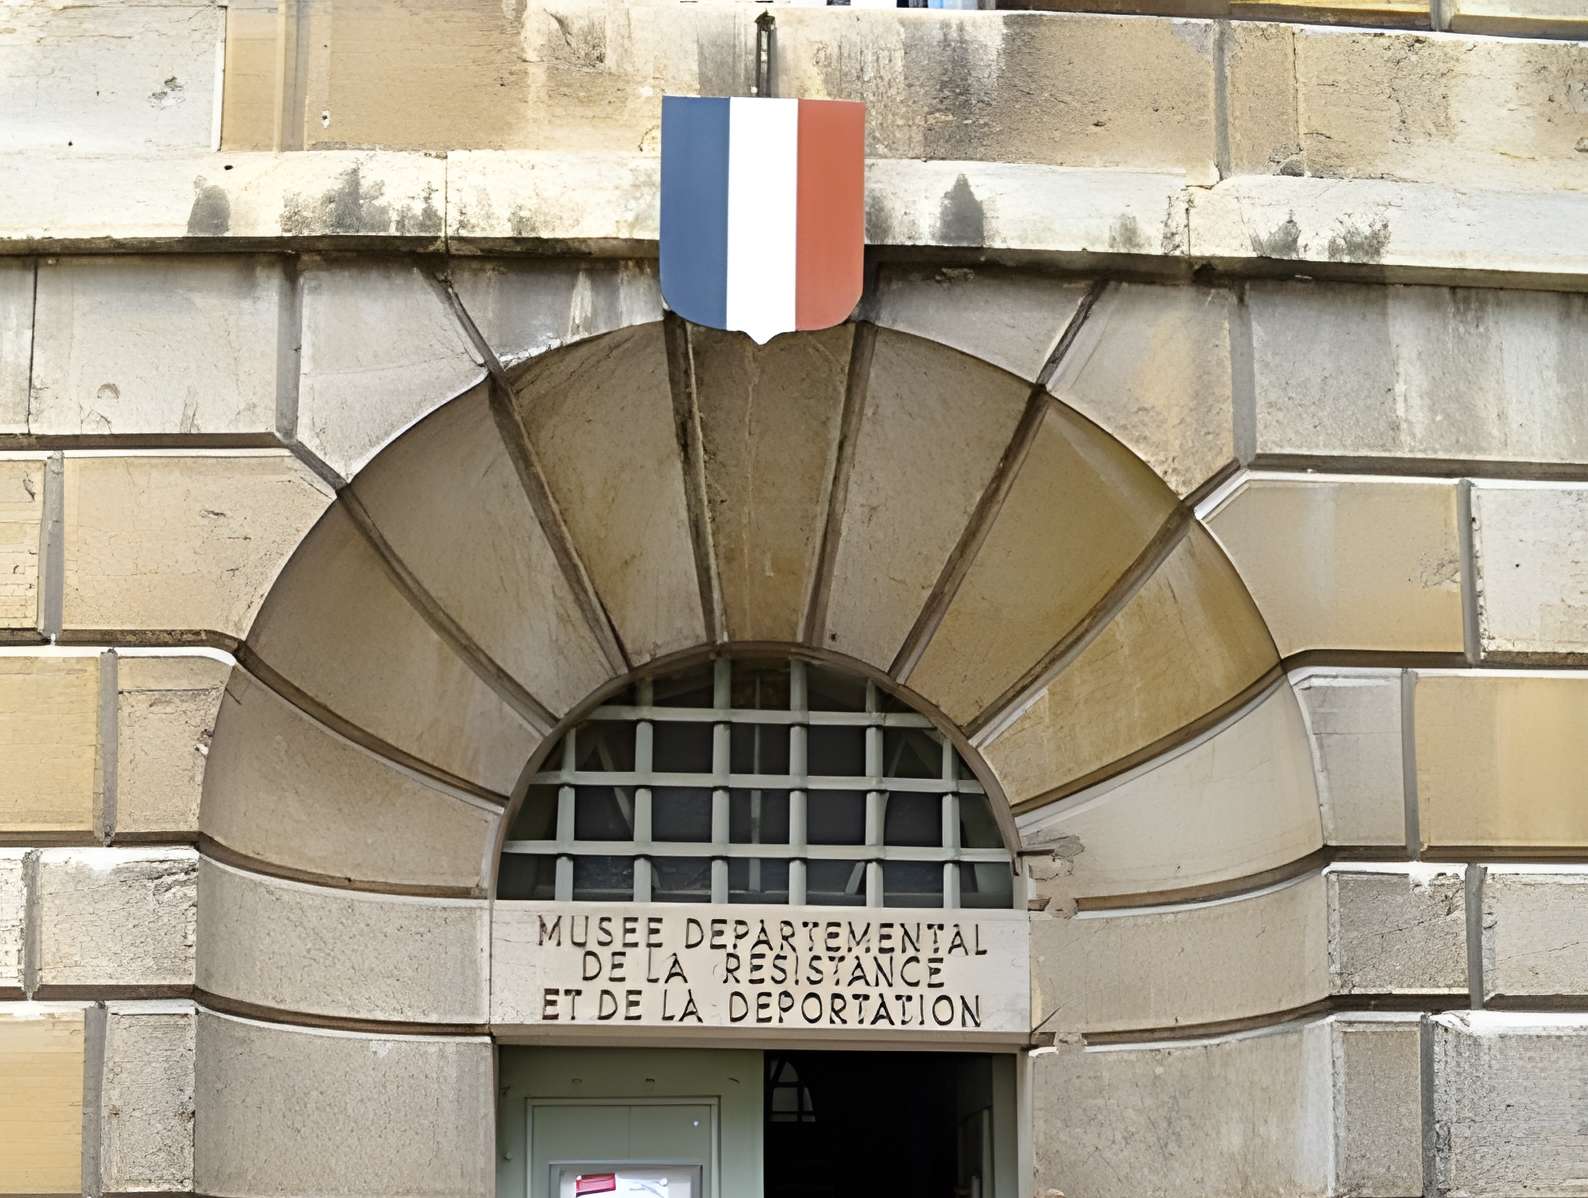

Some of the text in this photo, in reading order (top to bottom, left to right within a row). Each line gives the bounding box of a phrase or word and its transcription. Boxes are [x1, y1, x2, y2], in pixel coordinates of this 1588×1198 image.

[538, 915, 988, 955] MUSEE DEPARTEMENTAL
[582, 949, 945, 988] DE LA RESISTANCE
[542, 988, 982, 1027] ET DE LA DEPORTATION
